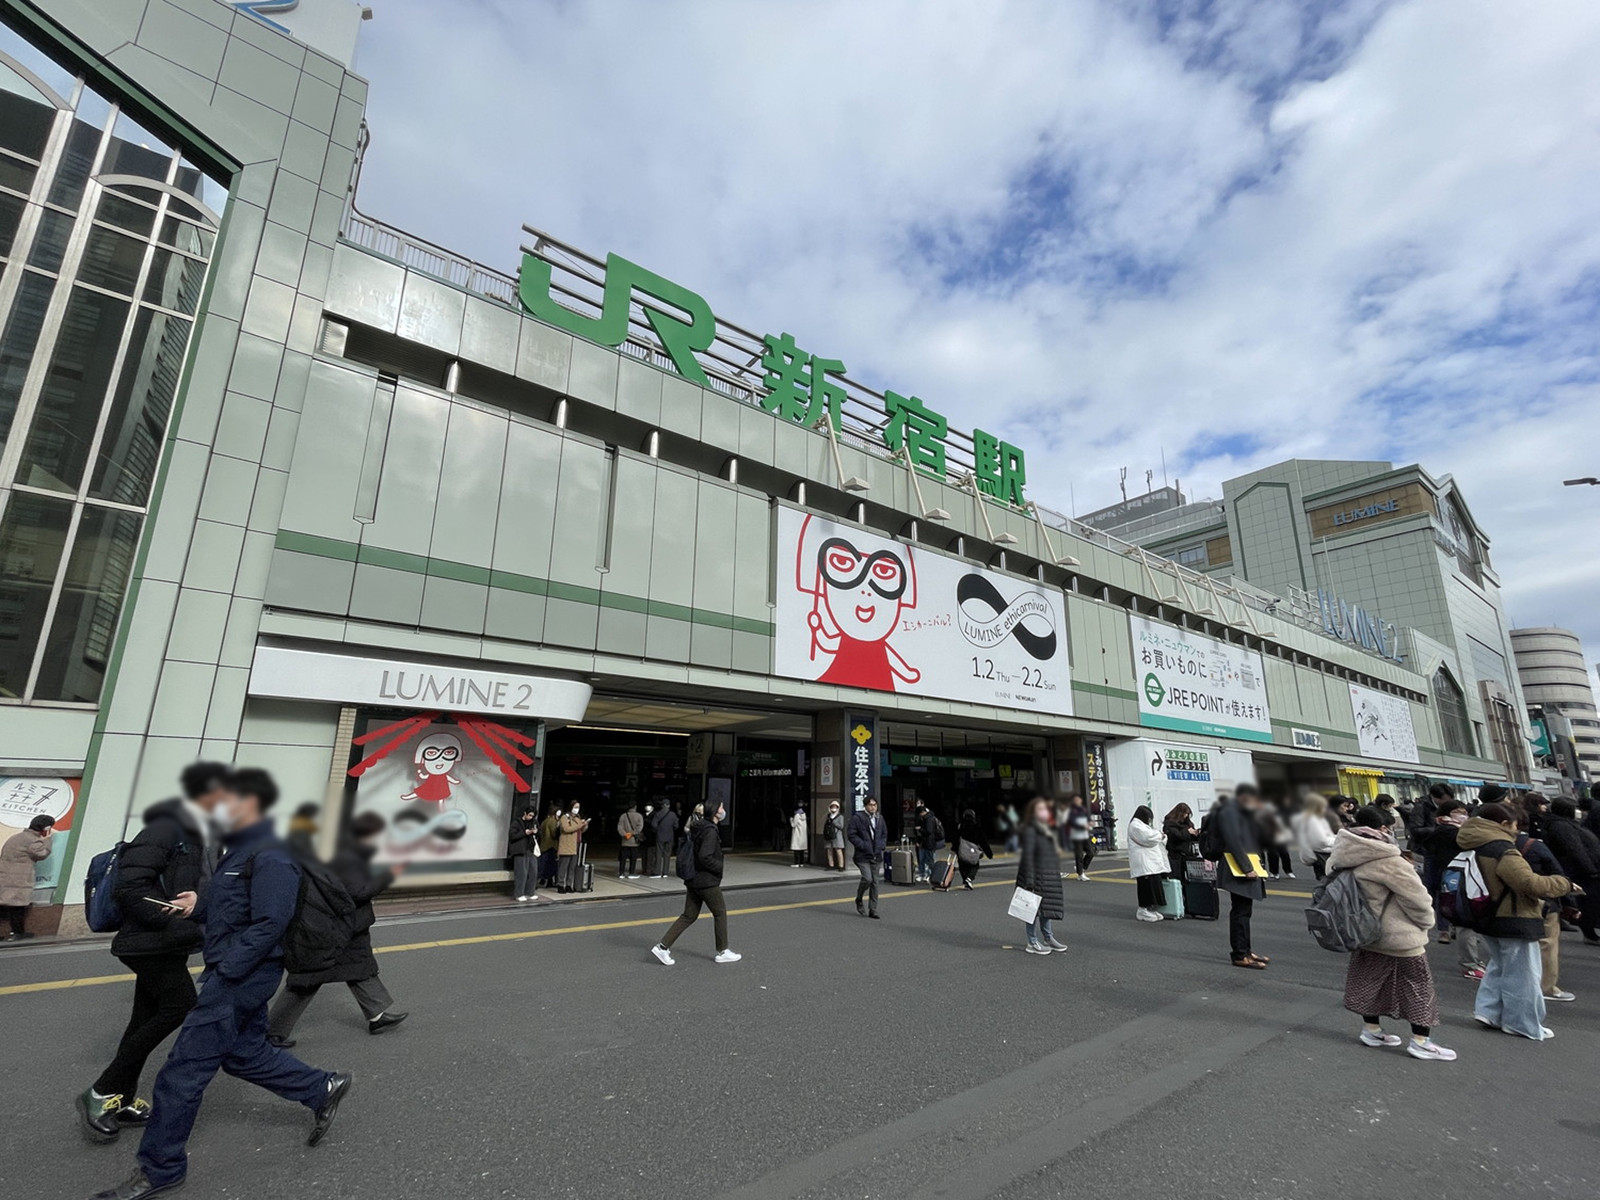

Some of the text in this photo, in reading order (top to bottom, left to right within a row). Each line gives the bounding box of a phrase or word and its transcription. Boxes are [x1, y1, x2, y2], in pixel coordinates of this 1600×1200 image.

[518, 252, 1027, 514] JR 新宿駅
[1333, 499, 1399, 526] LUMINE
[964, 599, 1048, 642] LUMINE ethicarnival
[1318, 586, 1388, 658] LUMINE
[972, 656, 995, 680] 1.2
[996, 671, 1010, 683] Thu
[1022, 666, 1043, 689] 2.2
[1043, 680, 1056, 691] Sun
[1142, 647, 1207, 678] お買いものに
[379, 670, 533, 710] LUMINE 2
[1167, 687, 1190, 708] JRE
[762, 767, 792, 776] Information
[910, 755, 920, 764] JR
[1087, 753, 1097, 803] ステップ
[1174, 771, 1189, 780] VIEW
[2, 802, 47, 814] KITCHEN
